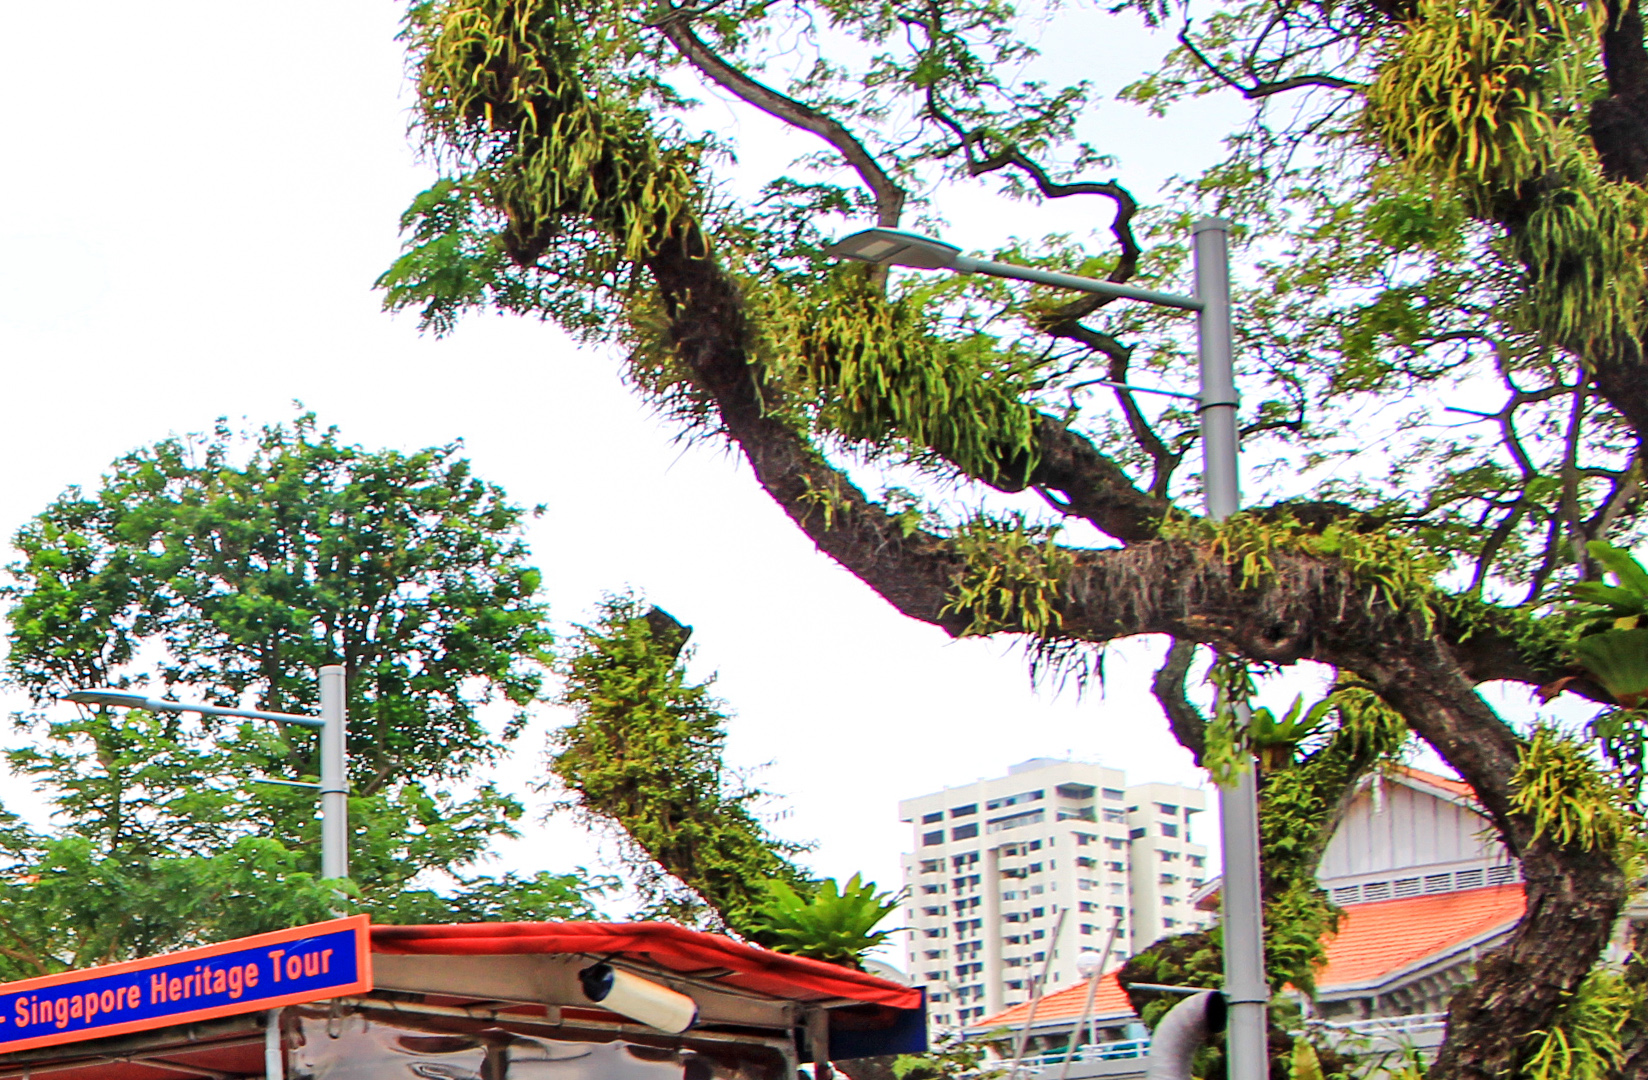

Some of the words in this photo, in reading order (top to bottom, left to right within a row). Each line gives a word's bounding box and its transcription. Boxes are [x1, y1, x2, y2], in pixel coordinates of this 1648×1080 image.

[14, 984, 141, 1029] Singapore
[150, 962, 259, 1005] Heritage
[268, 948, 334, 982] Tour
